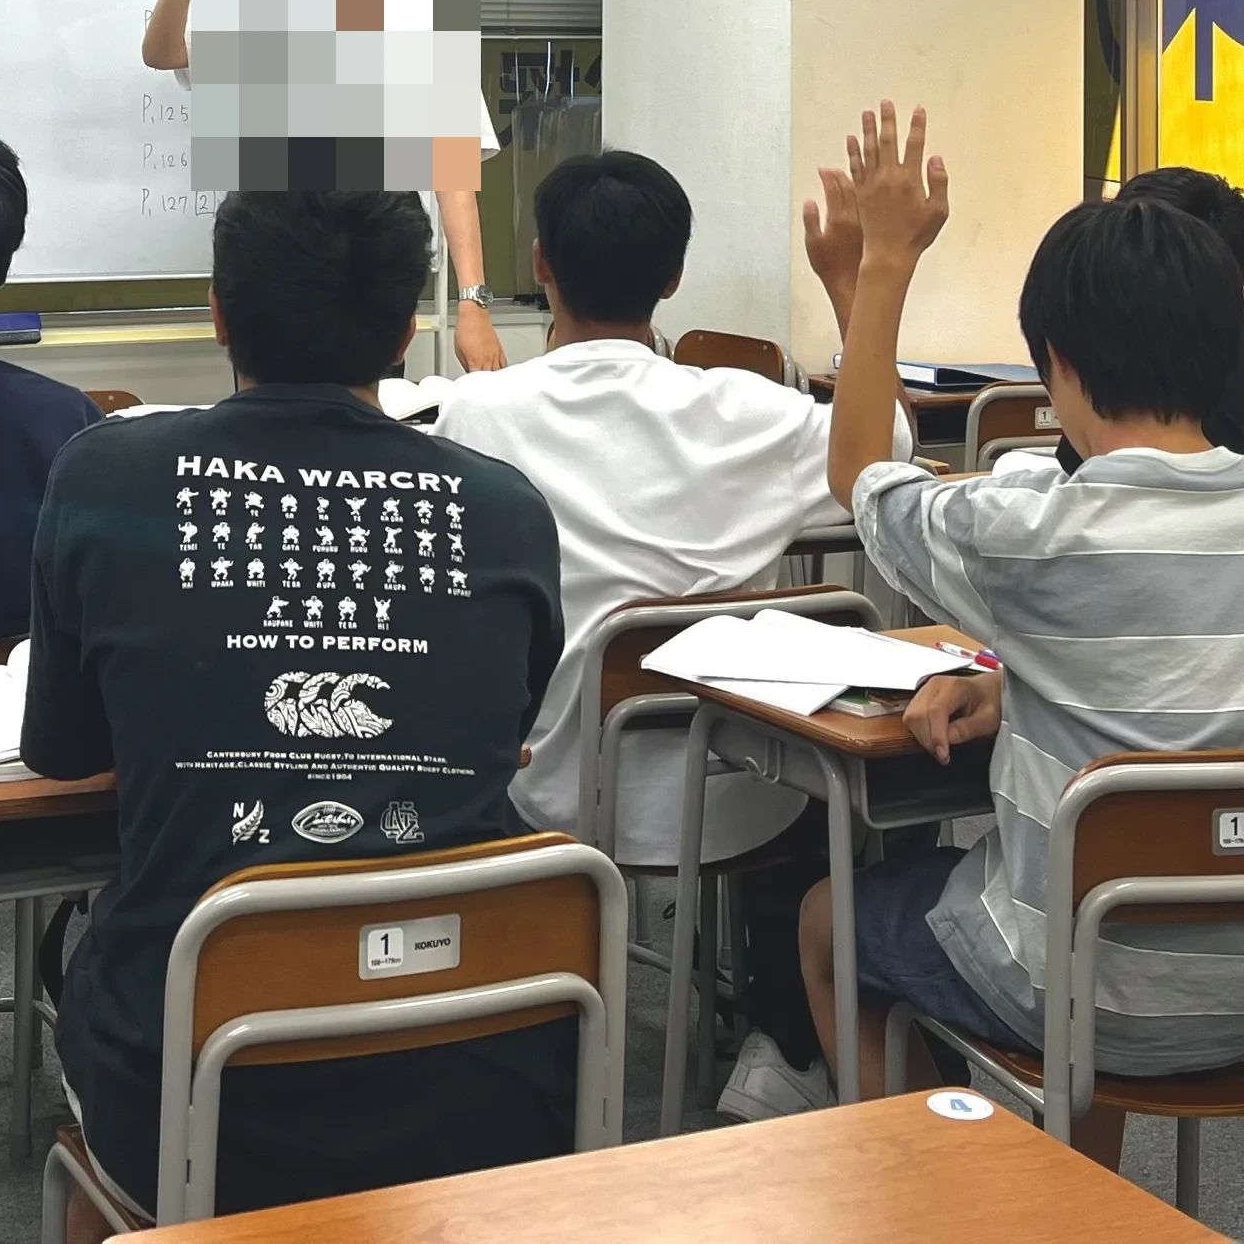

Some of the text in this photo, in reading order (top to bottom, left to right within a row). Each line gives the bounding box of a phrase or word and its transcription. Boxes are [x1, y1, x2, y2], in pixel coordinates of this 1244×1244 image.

[176, 455, 463, 494] HAKA WARCRY
[226, 634, 428, 654] HOW TO PERFORM
[233, 802, 245, 818] N
[258, 829, 270, 843] Z
[1230, 816, 1238, 836] 1
[380, 933, 451, 955] 1 KOKUYO
